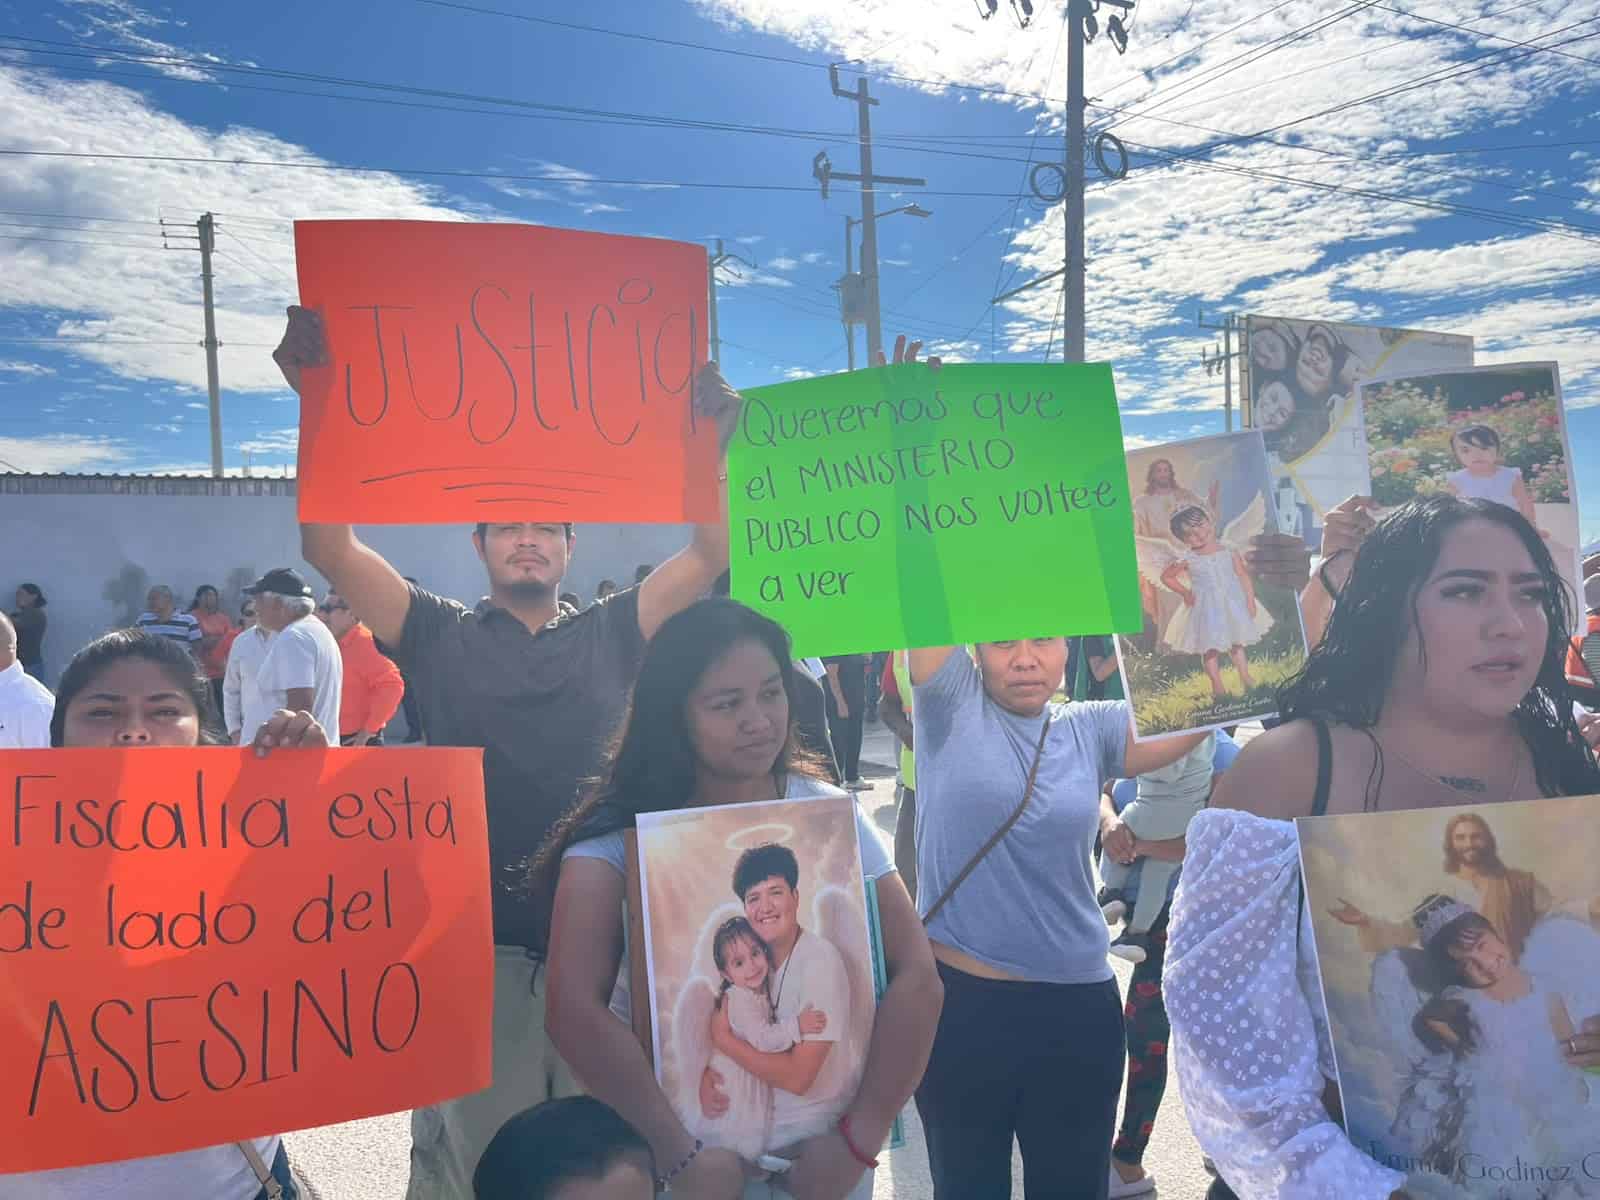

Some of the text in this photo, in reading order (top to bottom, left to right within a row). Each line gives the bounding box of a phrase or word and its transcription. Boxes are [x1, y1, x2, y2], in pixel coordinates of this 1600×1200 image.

[742, 391, 1064, 448] Queremos que
[745, 438, 1014, 502] el MINISTERIO
[747, 508, 881, 556] PUBLICO
[905, 495, 978, 534] NOS
[759, 573, 785, 602] a
[328, 776, 456, 845] esta
[0, 868, 393, 953] de lado del
[28, 962, 421, 1117] ASESINO
[1459, 1152, 1571, 1181] Godinez
